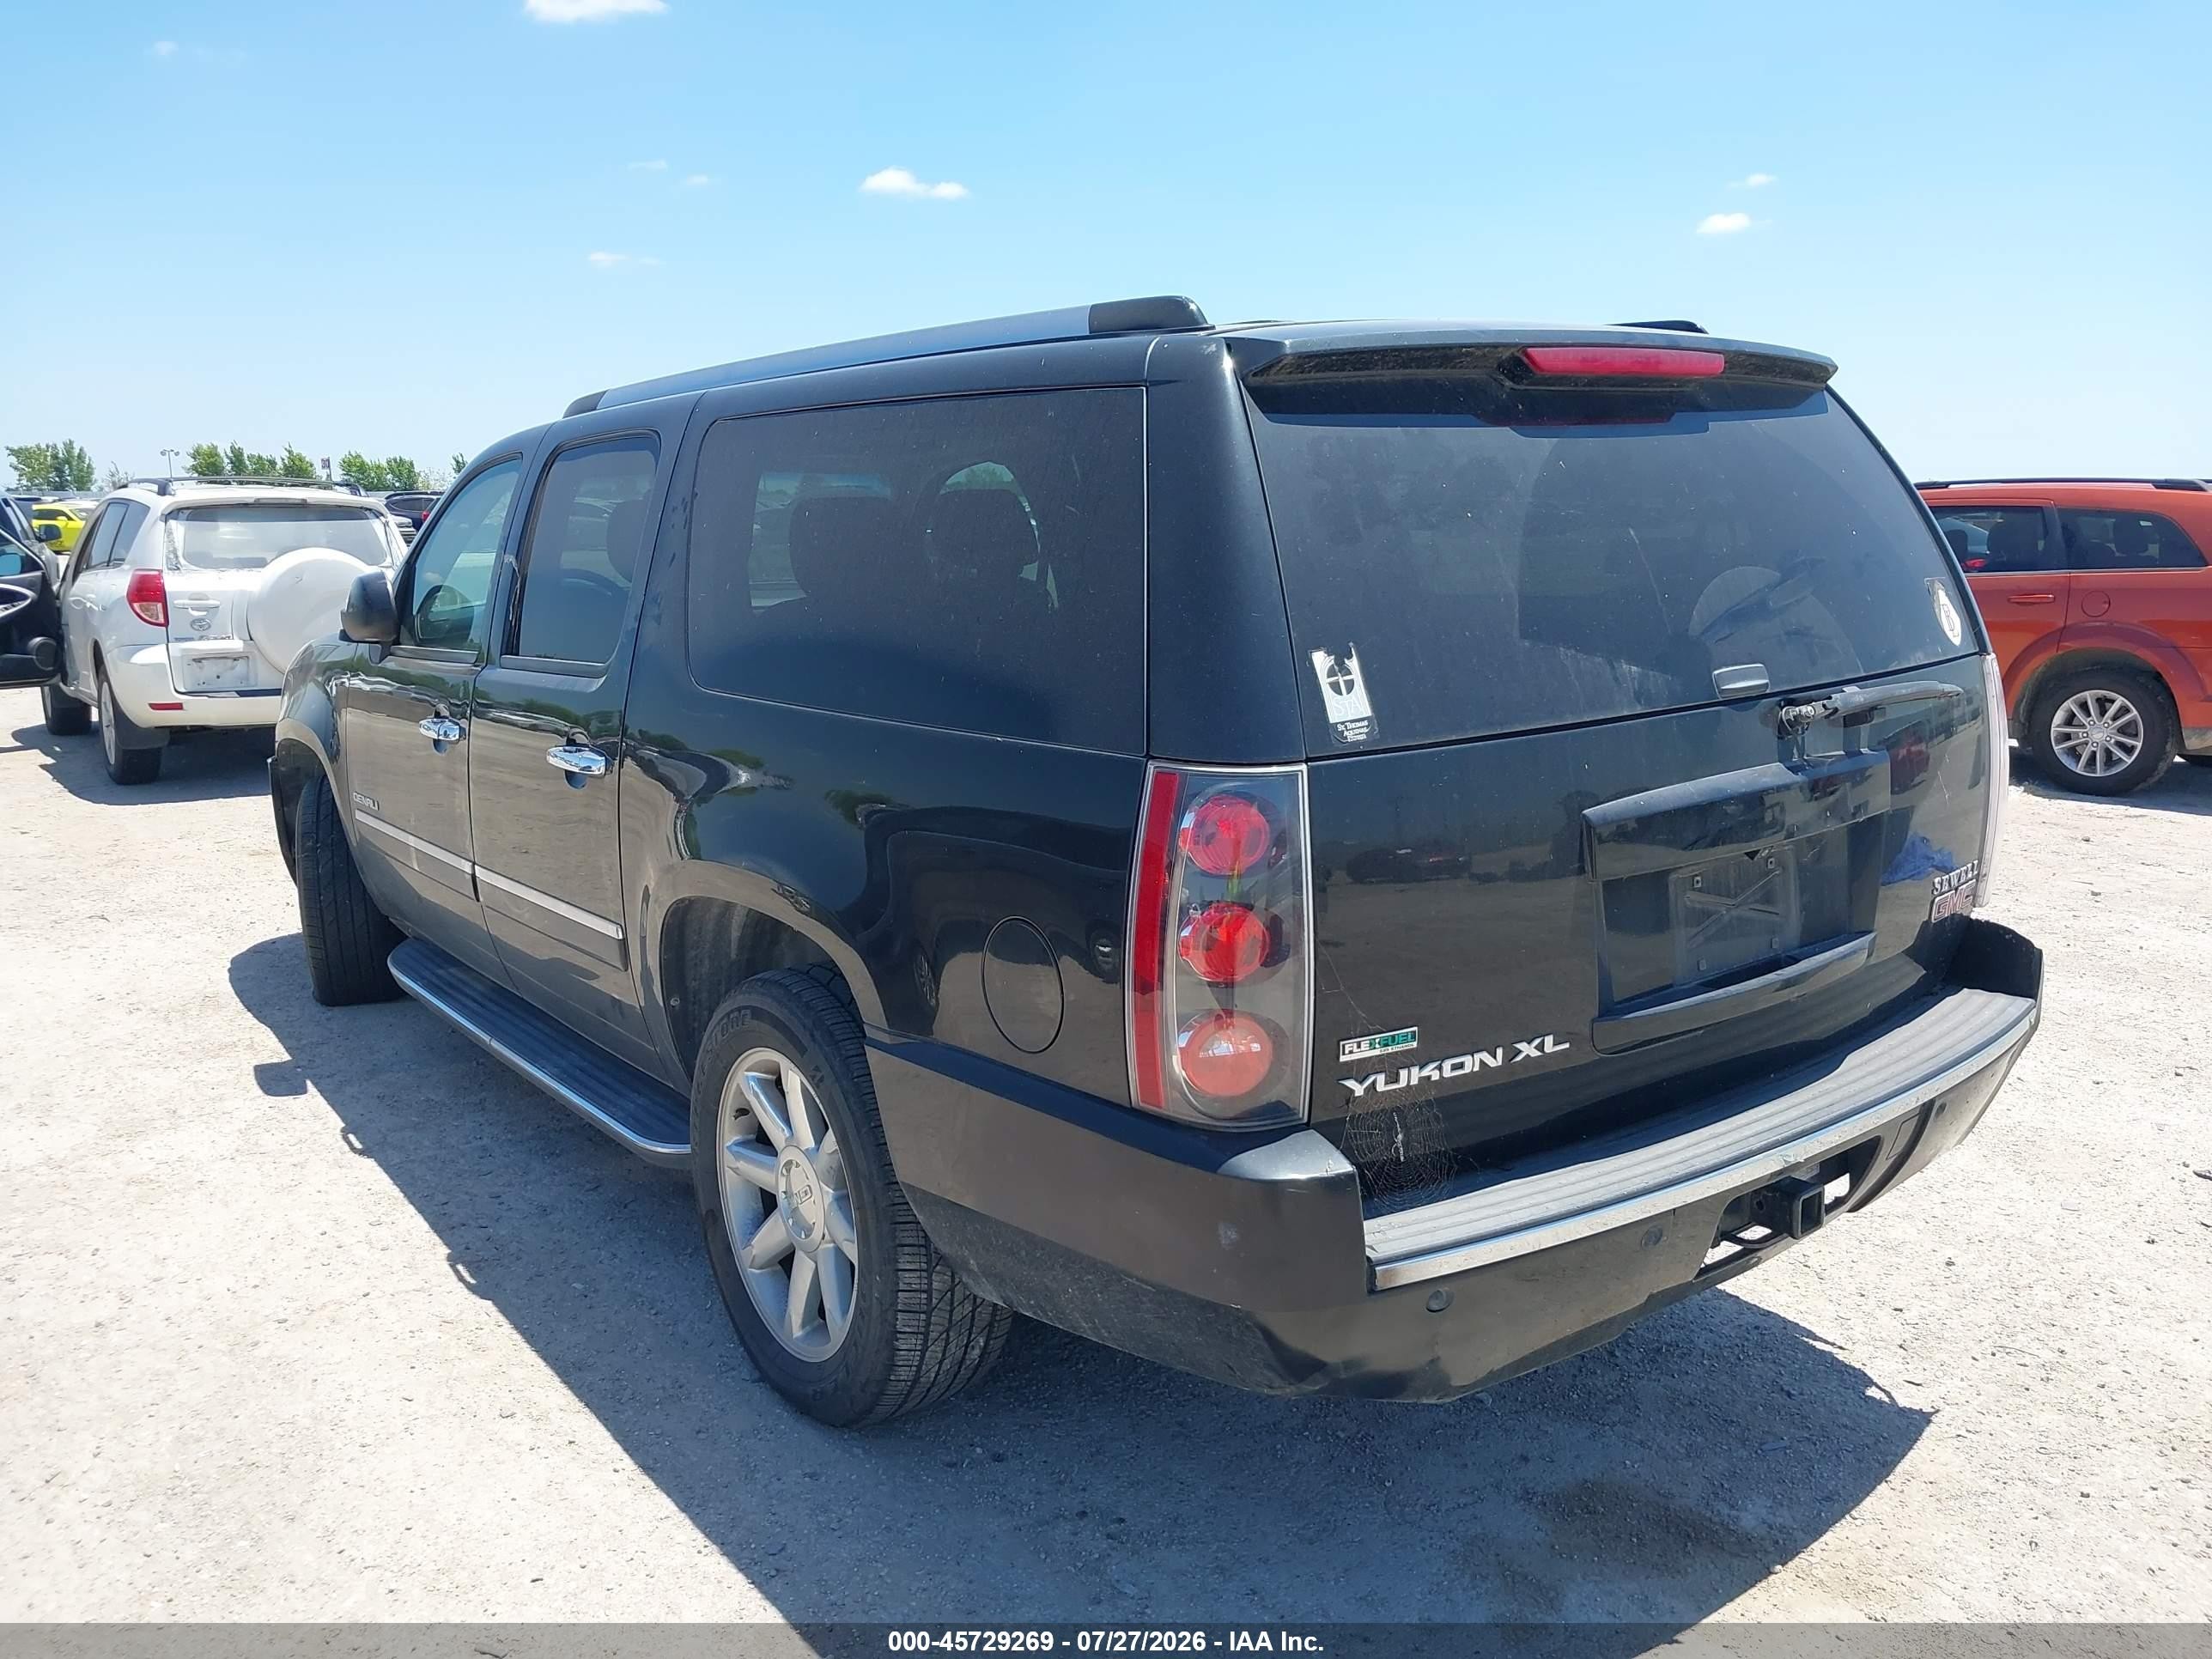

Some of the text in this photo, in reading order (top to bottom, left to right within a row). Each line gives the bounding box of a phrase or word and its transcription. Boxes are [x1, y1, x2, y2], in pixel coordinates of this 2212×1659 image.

[353, 791, 380, 811] DENALI
[1932, 860, 1978, 895] SEWELL
[1934, 882, 1976, 920] GMC
[1338, 1033, 1571, 1097] YUKON XL
